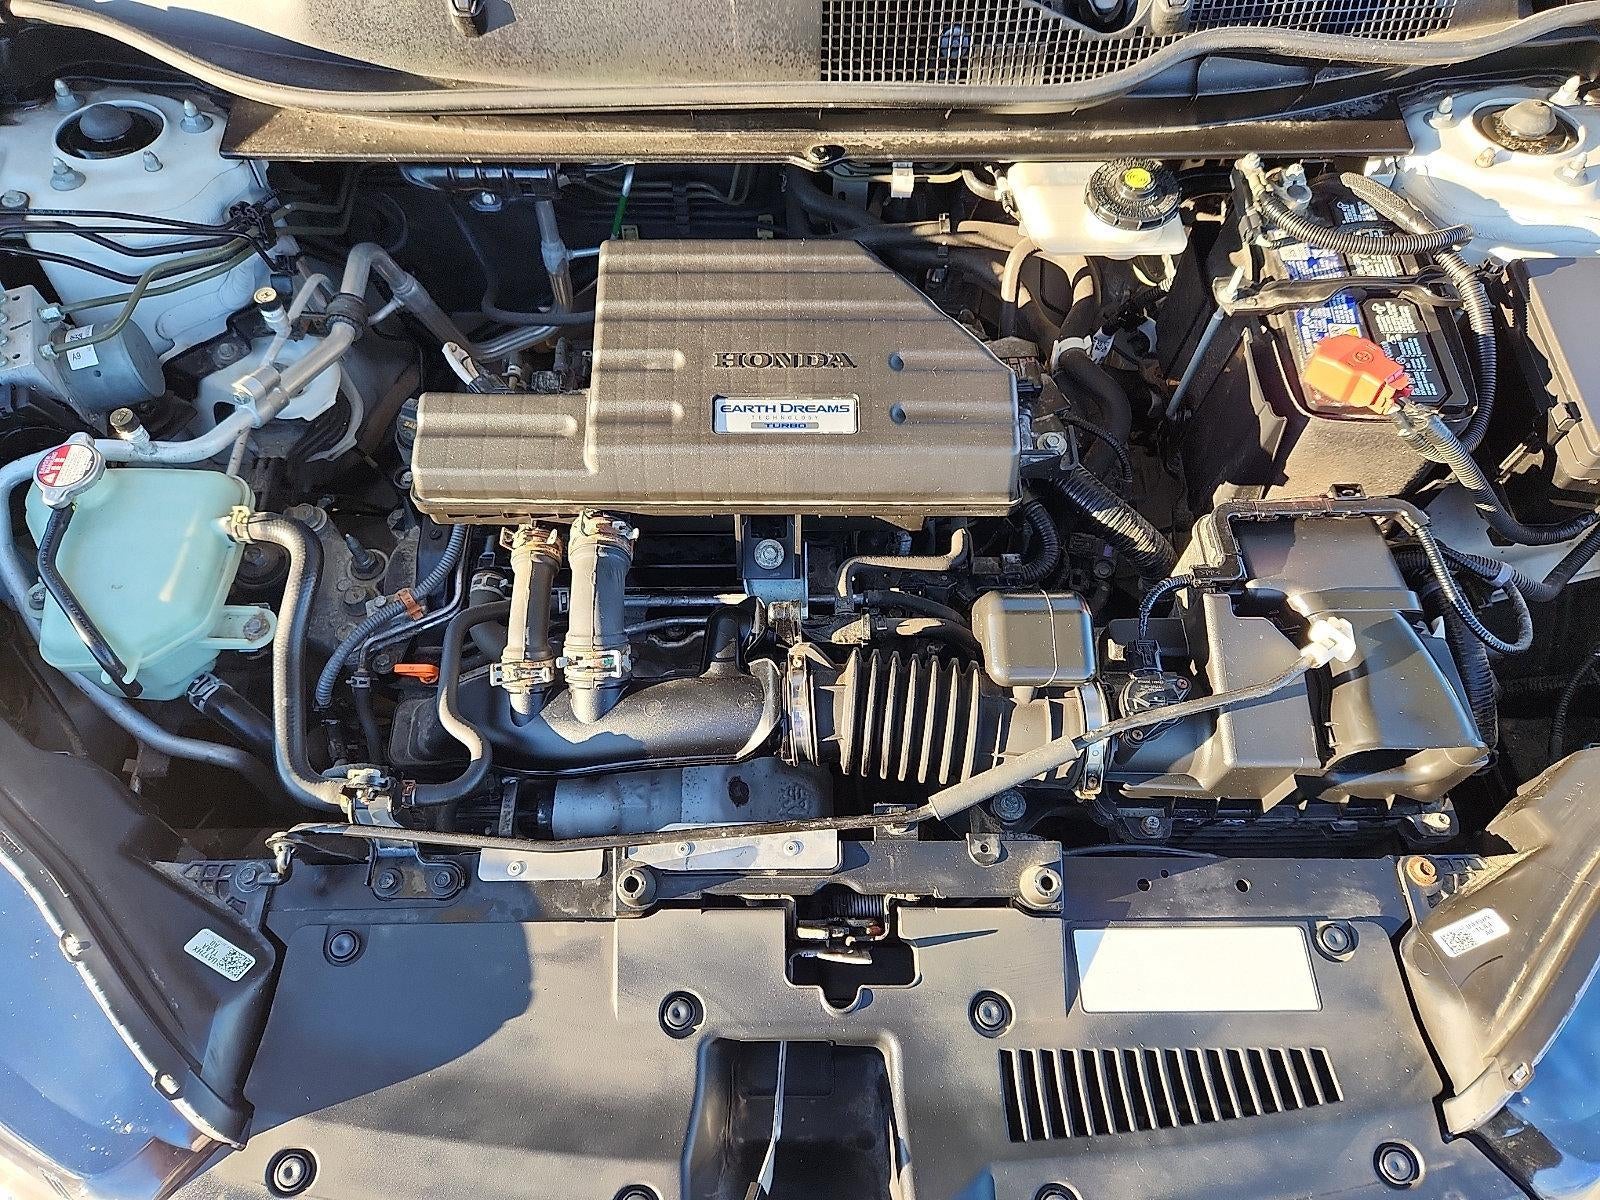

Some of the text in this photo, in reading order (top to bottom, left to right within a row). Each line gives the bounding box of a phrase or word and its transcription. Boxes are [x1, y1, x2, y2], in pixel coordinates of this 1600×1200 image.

[713, 352, 858, 369] HONDA
[720, 403, 850, 413] EARTH DREAMS
